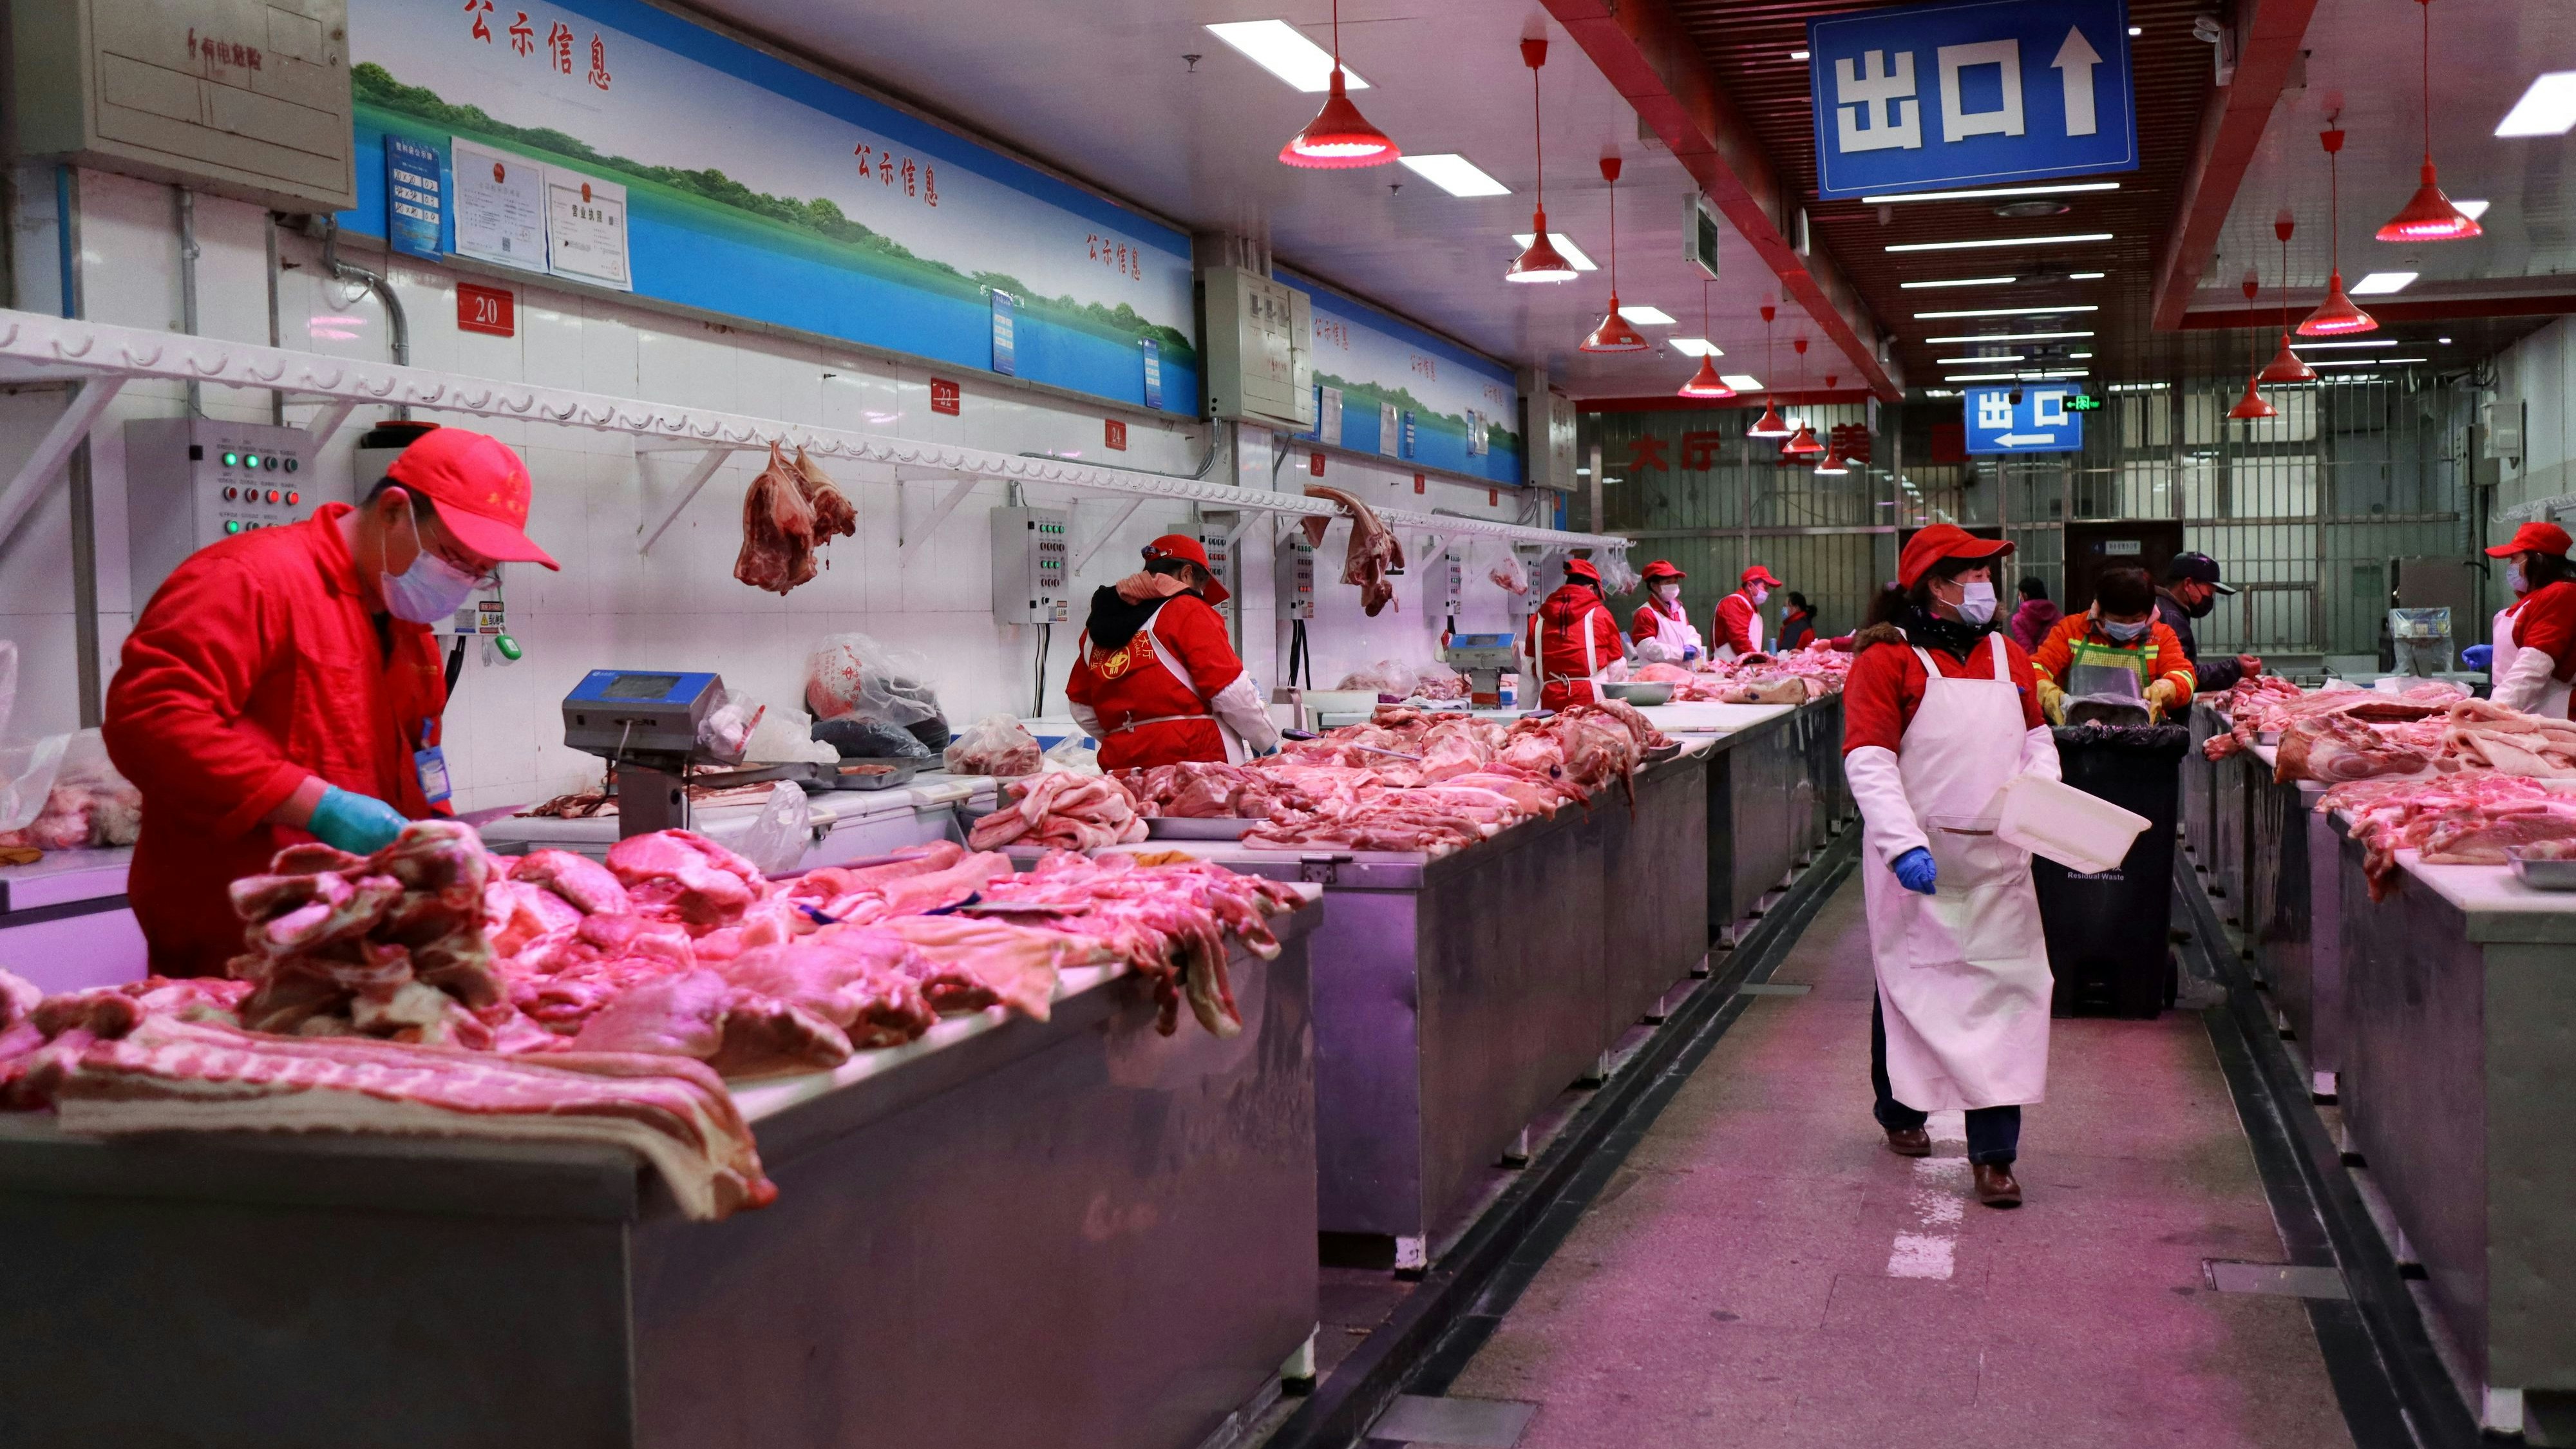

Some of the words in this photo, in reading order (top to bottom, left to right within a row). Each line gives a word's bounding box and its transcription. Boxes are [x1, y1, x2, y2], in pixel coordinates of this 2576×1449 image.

[464, 0, 611, 91] 公示信息
[1835, 39, 2024, 153] 出口
[854, 142, 938, 207] 公示信息
[572, 204, 603, 223] 营业执照
[1086, 234, 1141, 281] 公示信息
[476, 296, 498, 324] 20
[940, 387, 951, 407] 22
[1978, 390, 2068, 429] 出口
[1112, 426, 1121, 444] 24
[1628, 431, 1720, 472] 大厅
[2067, 871, 2099, 880] Residual
